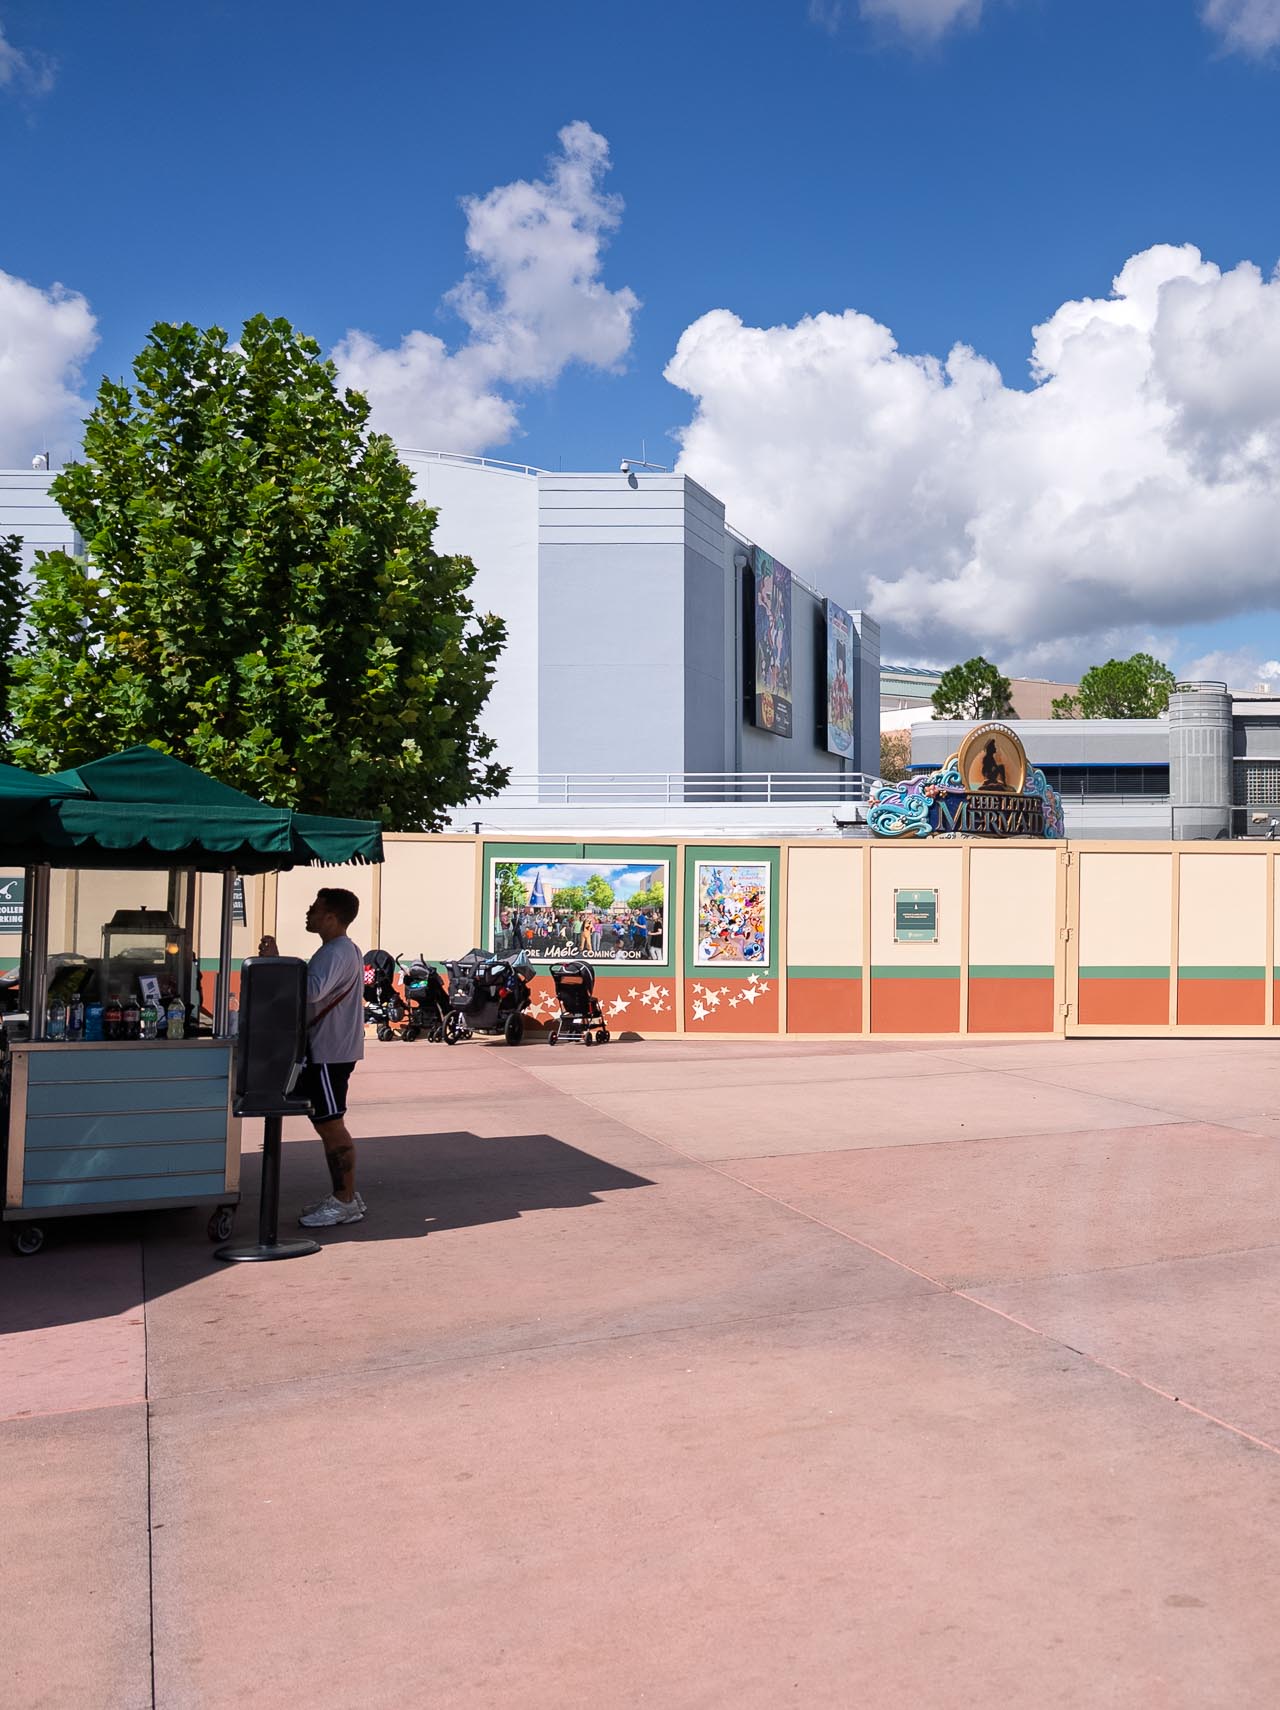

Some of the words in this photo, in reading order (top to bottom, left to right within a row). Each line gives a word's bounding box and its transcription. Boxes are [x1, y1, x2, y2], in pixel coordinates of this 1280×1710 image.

[967, 795, 999, 810] THE
[1001, 796, 1041, 814] LITTLE
[935, 800, 1045, 837] MERMAID
[523, 949, 540, 957] ORE
[544, 941, 580, 958] MAGIC
[582, 950, 615, 958] COMING
[622, 950, 641, 958] OON
